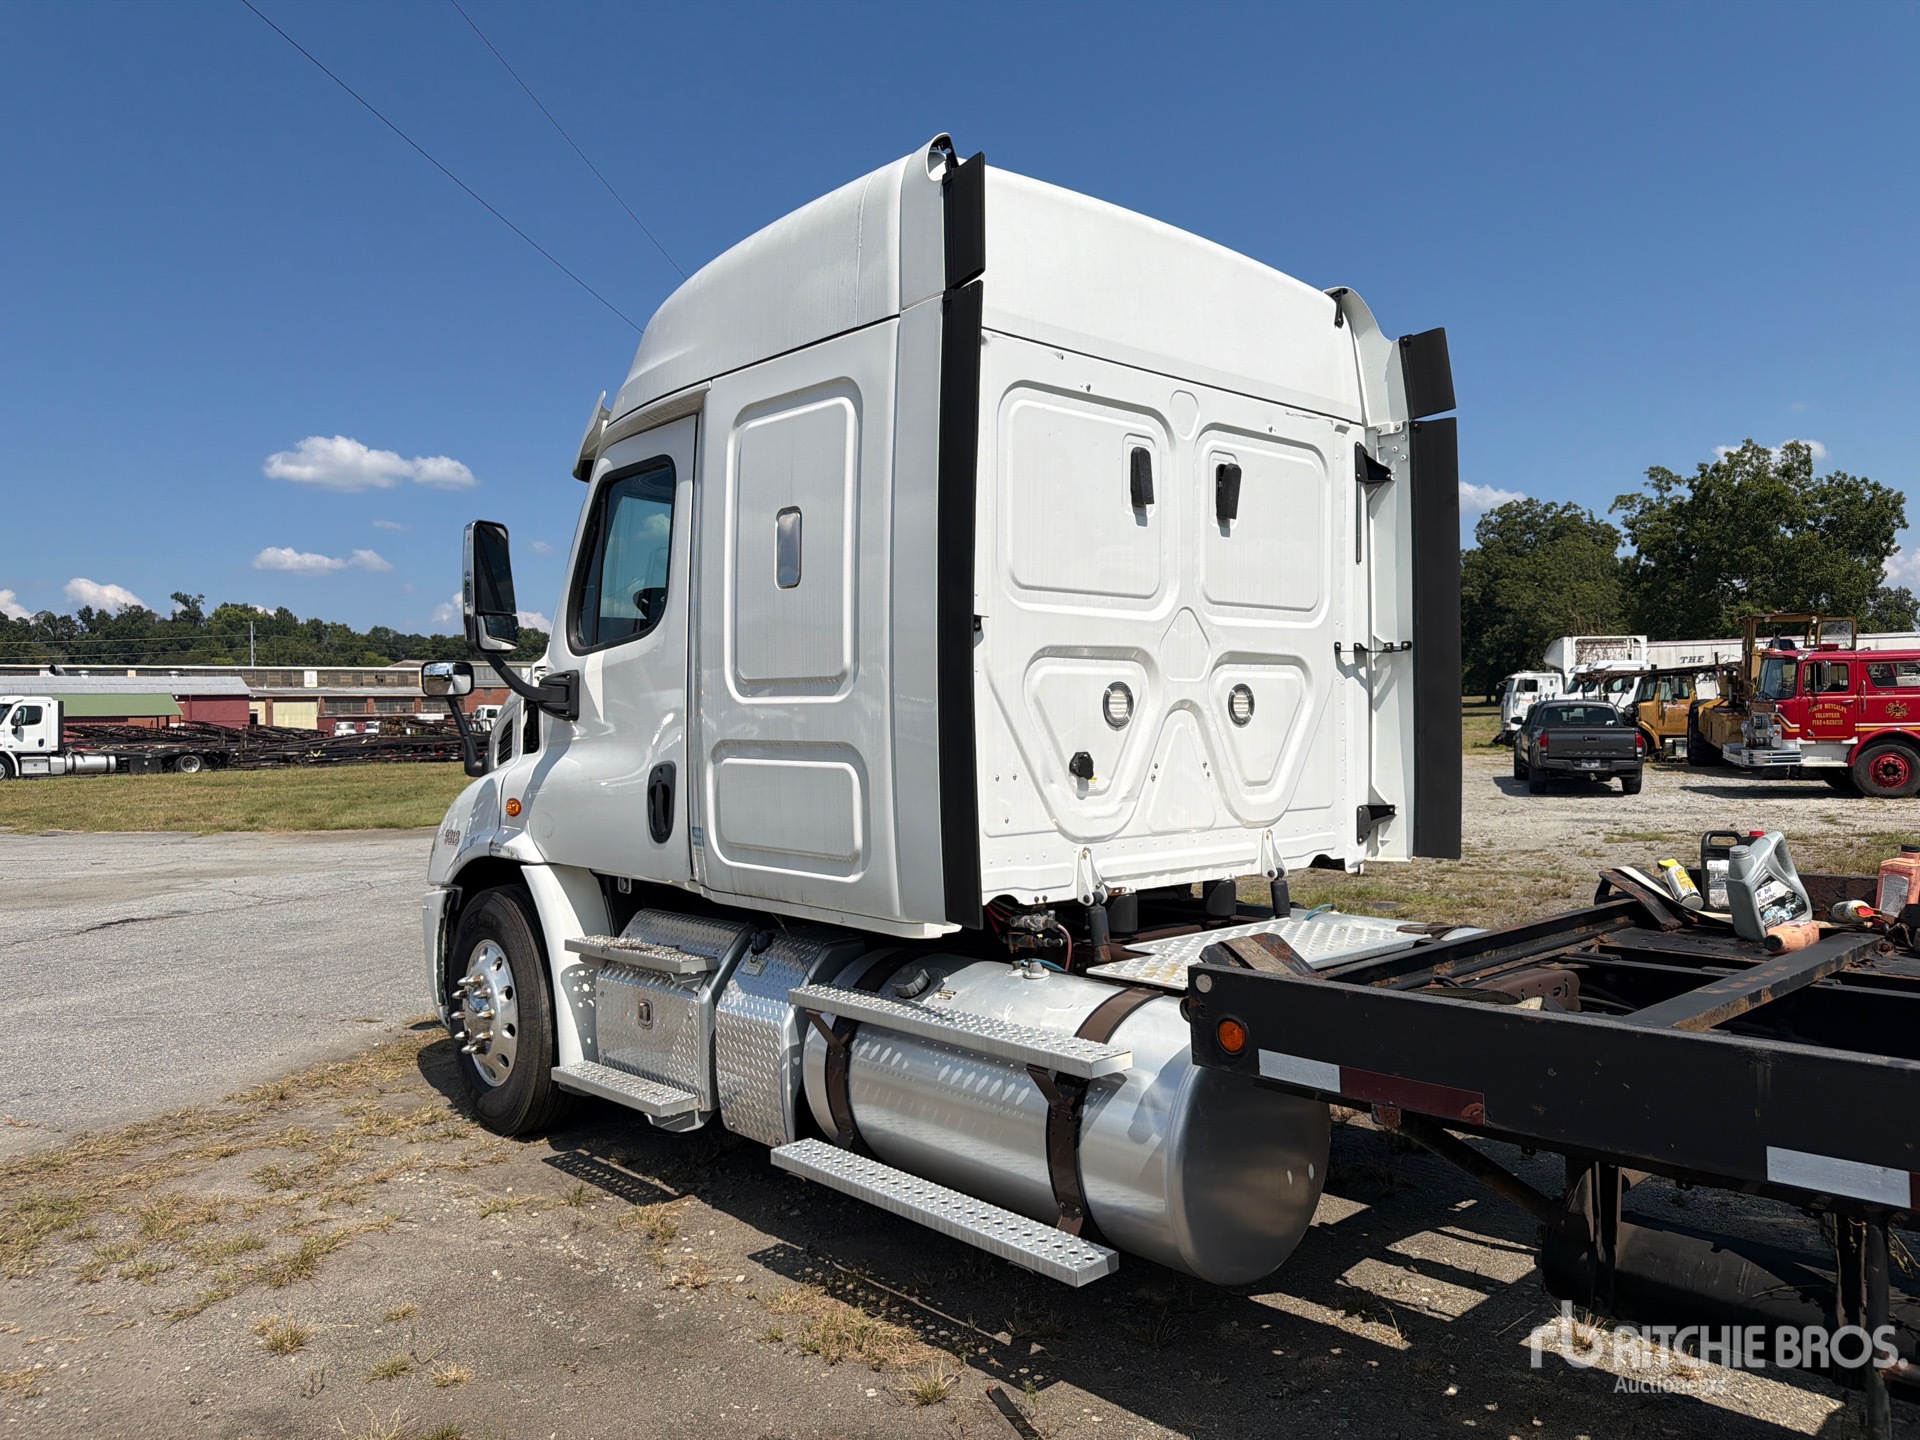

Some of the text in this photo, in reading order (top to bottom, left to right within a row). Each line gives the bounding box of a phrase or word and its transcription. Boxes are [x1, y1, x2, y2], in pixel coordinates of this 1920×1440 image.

[1679, 655, 1705, 664] THE
[444, 829, 460, 846] 9313
[1757, 892, 1777, 906] Delvac
